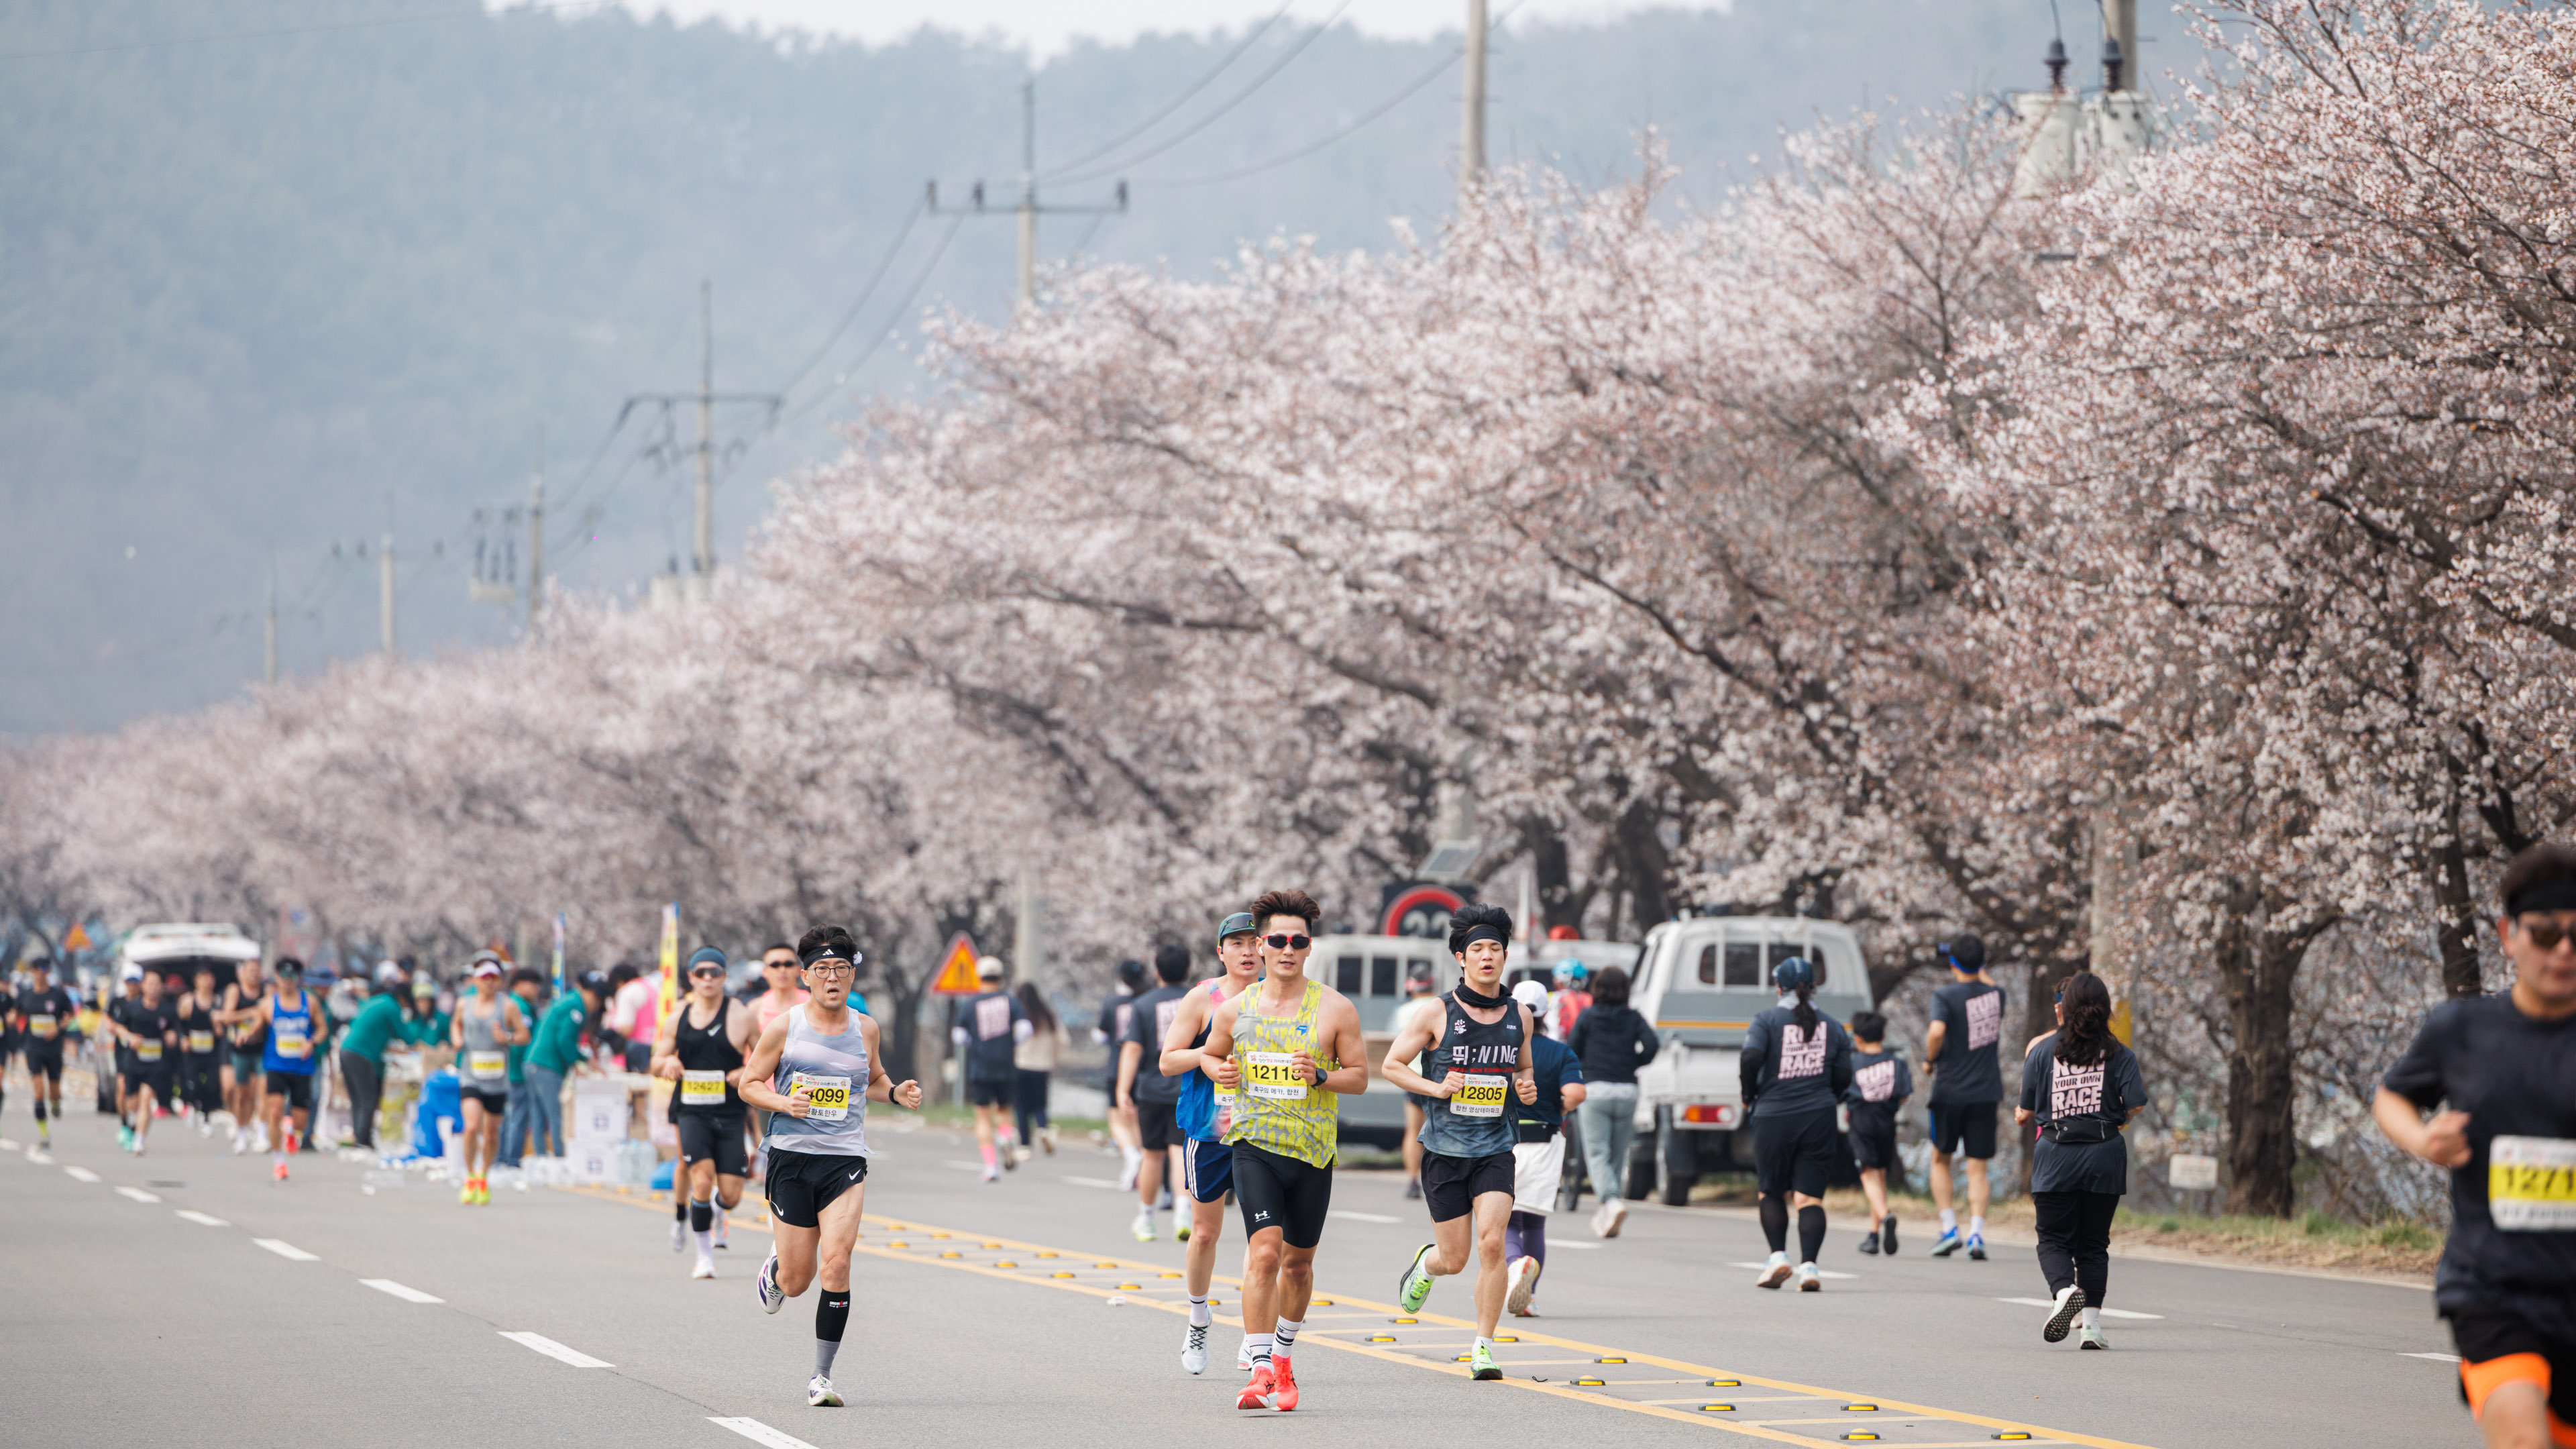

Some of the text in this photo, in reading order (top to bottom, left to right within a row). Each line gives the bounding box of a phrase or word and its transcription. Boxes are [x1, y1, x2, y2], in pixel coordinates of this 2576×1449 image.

[1783, 1021, 1827, 1044] RN
[1780, 1053, 1825, 1073] RACE
[2055, 1075, 2101, 1088] YOUR OWN
[796, 1085, 845, 1103] 4099
[1460, 1085, 1503, 1100] 12805
[2051, 1087, 2102, 1112] RACE
